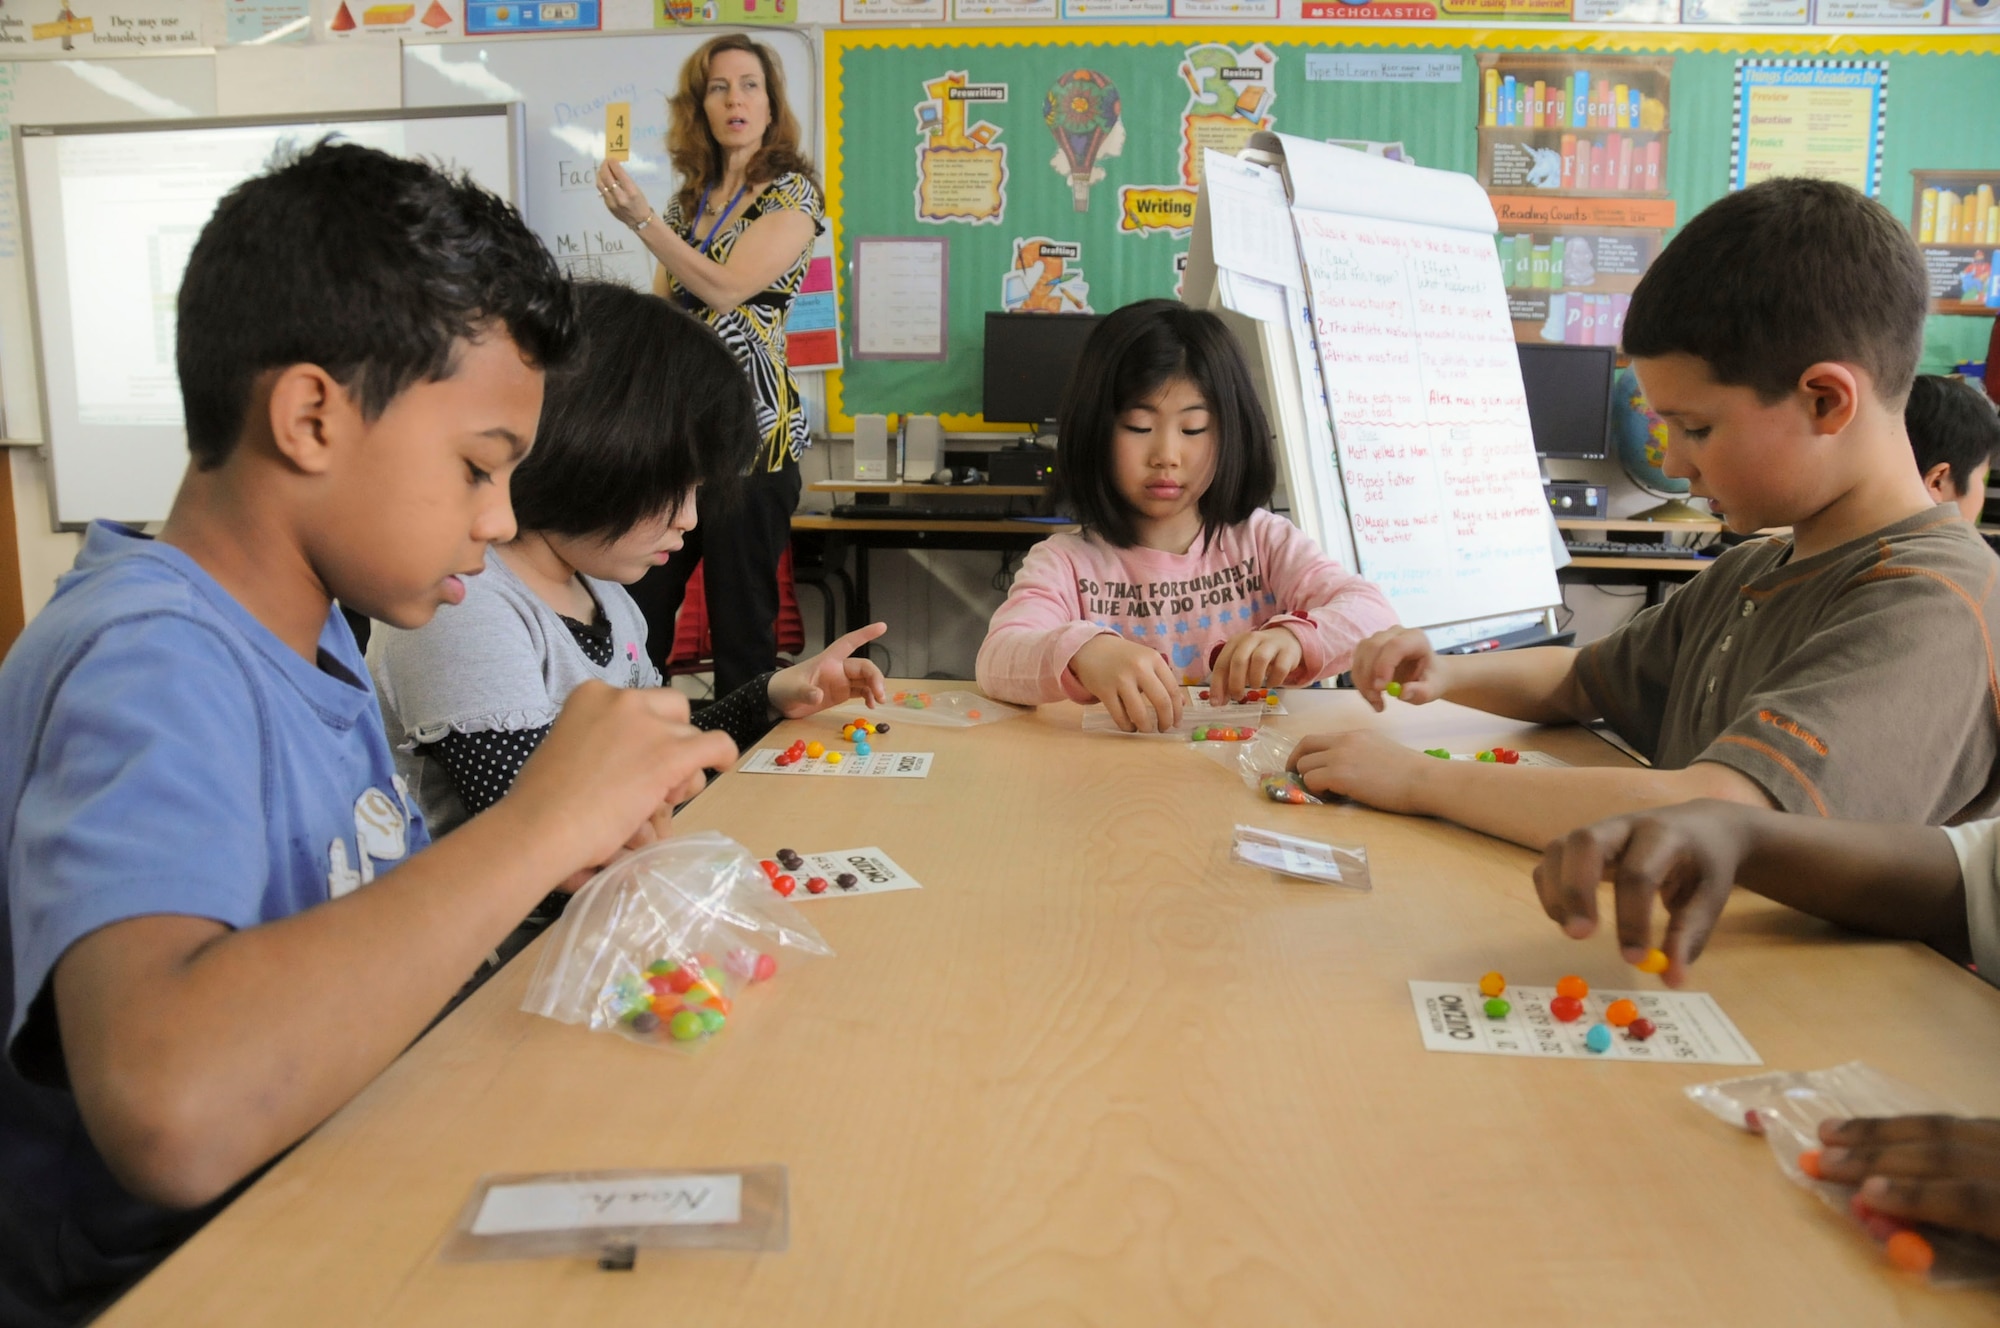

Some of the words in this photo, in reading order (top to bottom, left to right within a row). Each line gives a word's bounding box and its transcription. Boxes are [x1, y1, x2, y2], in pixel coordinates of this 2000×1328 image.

[1326, 7, 1432, 18] SCHOLASTIC
[110, 15, 134, 30] They
[138, 17, 158, 28] may
[161, 17, 180, 26] use
[93, 32, 148, 46] technology
[152, 33, 162, 42] as
[165, 33, 177, 42] an
[180, 31, 197, 42] aid.
[1222, 68, 1261, 79] Revising
[1308, 62, 1329, 81] Type
[1334, 62, 1345, 77] to
[1745, 69, 1781, 84] Things
[1784, 69, 1814, 83] Good
[1815, 70, 1861, 84] Readers
[1863, 71, 1878, 84] Do
[950, 88, 1003, 99] Prewriting
[1751, 92, 1790, 102] Preview
[1486, 92, 1565, 119] Literary
[1575, 95, 1639, 117] Genres
[615, 114, 624, 129] 4
[1750, 115, 1793, 126] Question
[614, 133, 624, 148] 4
[1749, 138, 1784, 148] Predict
[1563, 154, 1658, 178] Fiction
[1748, 161, 1774, 172] Infer
[1137, 199, 1192, 218] Writing
[1502, 204, 1549, 223] Reading
[1551, 204, 1588, 221] Counts
[556, 233, 580, 255] Me
[594, 231, 624, 252] You
[1040, 245, 1077, 257] Drafting
[1329, 320, 1348, 334] The
[1428, 388, 1452, 406] Alex
[1078, 577, 1100, 596] SO
[1104, 581, 1143, 601] THAT
[1148, 556, 1255, 599] FORTUNATELY
[1089, 598, 1120, 617] LIFE
[1126, 600, 1165, 618] MAY
[1171, 596, 1194, 615] DO
[1200, 585, 1235, 609] FOR
[1235, 574, 1262, 601] YOU
[846, 856, 889, 884] QUIZMO
[1437, 994, 1475, 1040] QUIZMO
